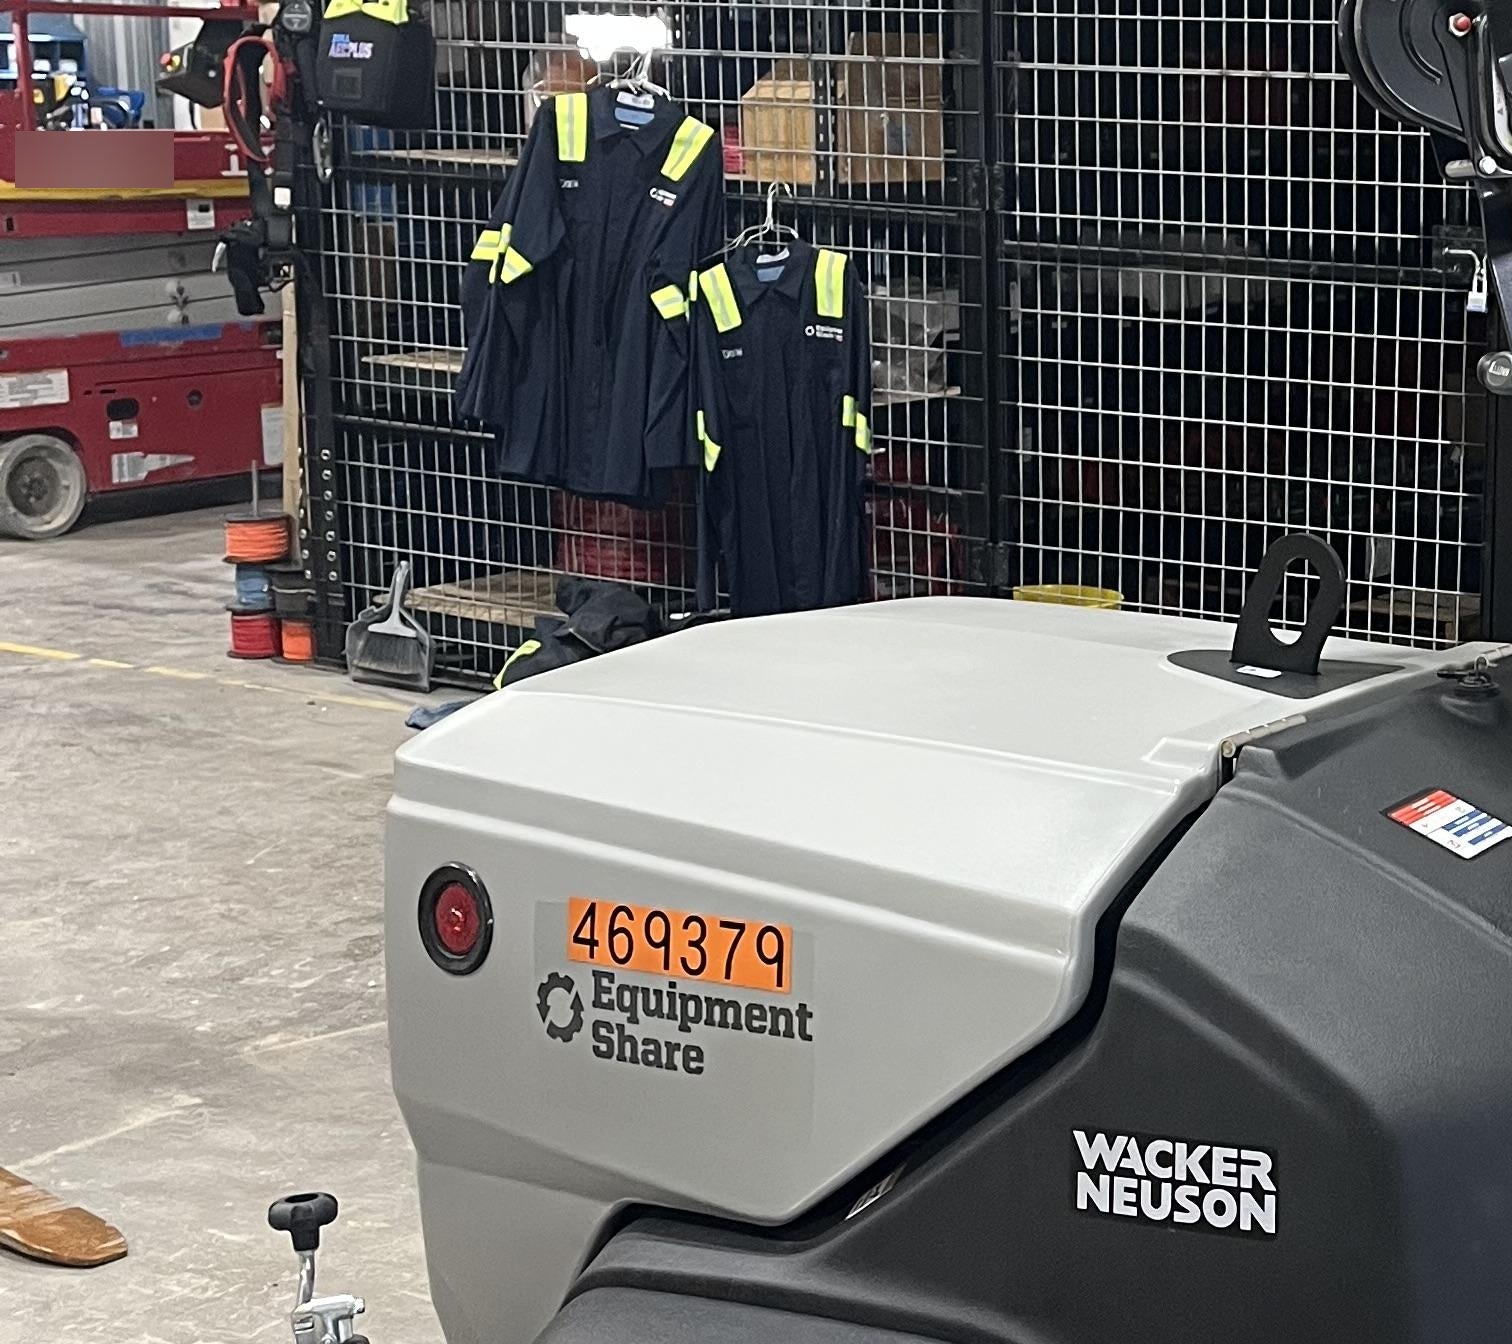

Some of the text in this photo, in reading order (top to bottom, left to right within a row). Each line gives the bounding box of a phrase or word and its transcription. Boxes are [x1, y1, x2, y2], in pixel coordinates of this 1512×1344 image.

[572, 902, 785, 988] 469379
[591, 969, 813, 1042] Equipment
[591, 1019, 705, 1075] Share
[1072, 1129, 1277, 1192] WACKER
[1076, 1171, 1276, 1234] NEUSON
